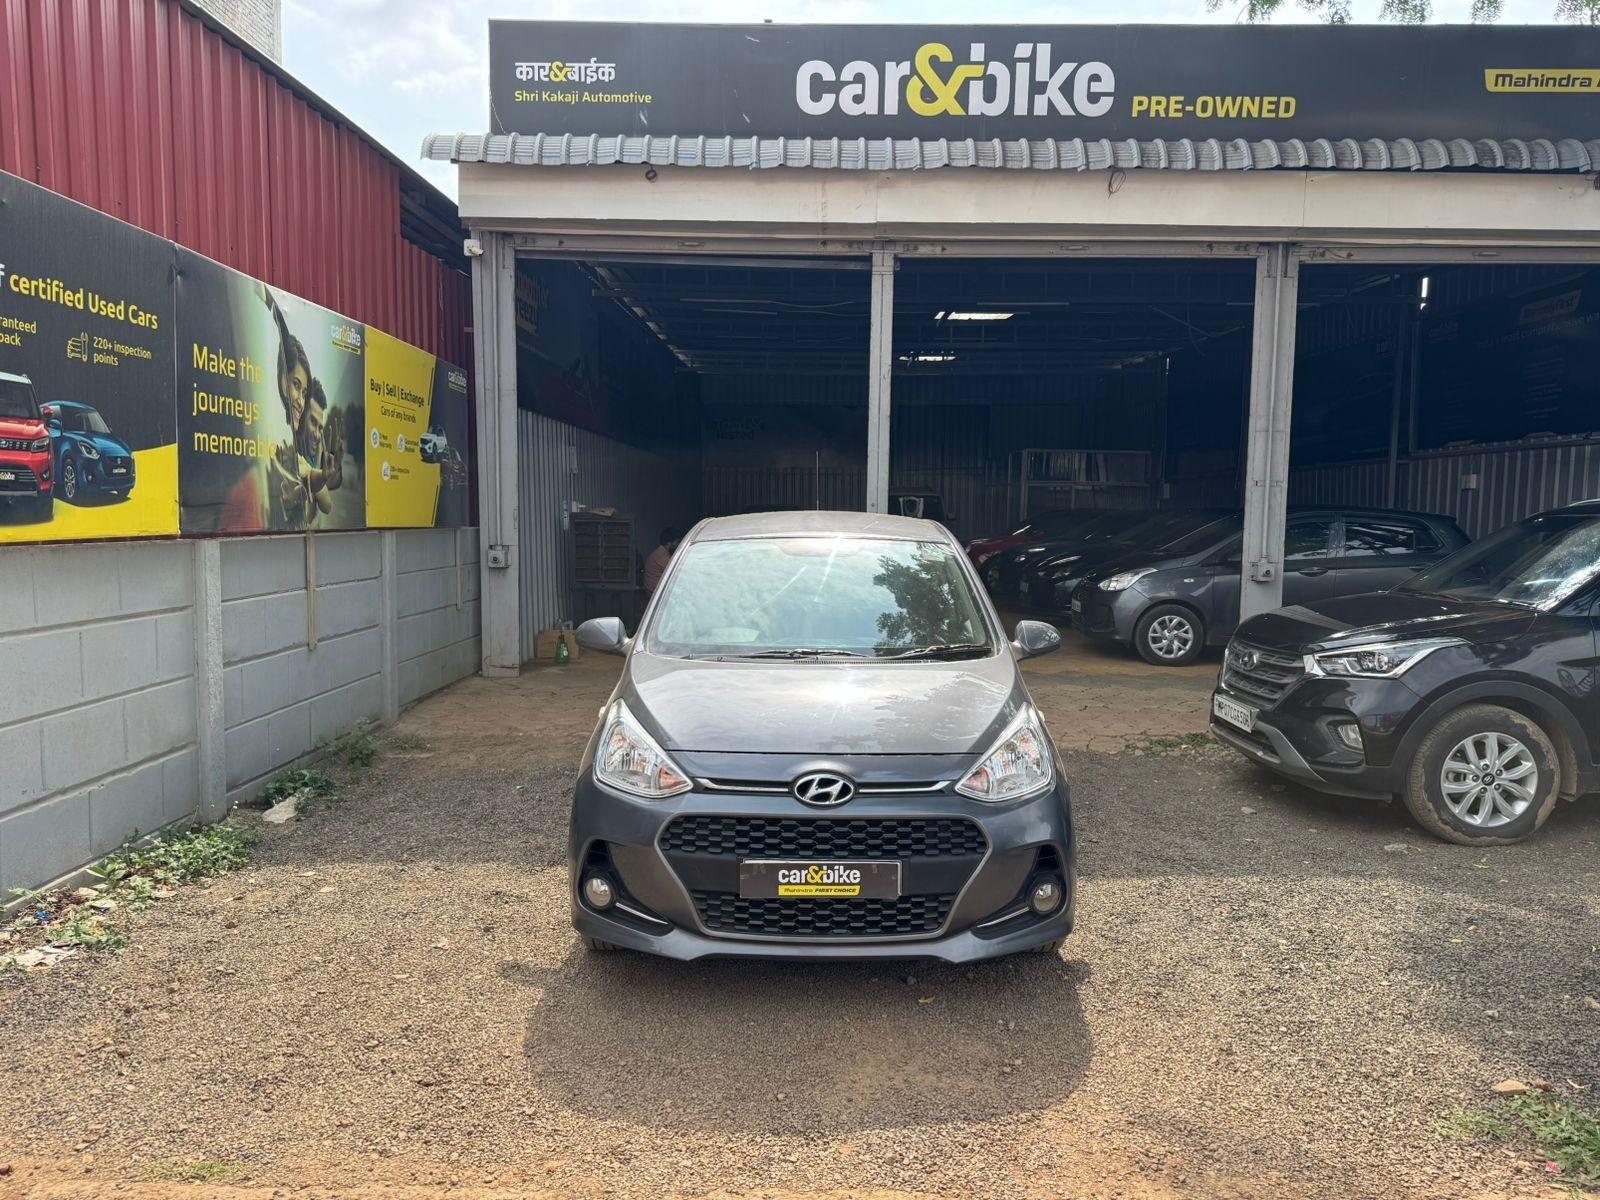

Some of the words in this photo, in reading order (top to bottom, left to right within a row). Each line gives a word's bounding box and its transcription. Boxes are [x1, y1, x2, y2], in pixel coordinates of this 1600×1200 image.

[796, 42, 1115, 117] car&bike
[1494, 73, 1593, 88] Mahindra
[514, 90, 539, 103] Shri
[542, 91, 579, 104] Kakaji
[582, 91, 652, 104] Automotive
[1131, 95, 1297, 119] PRE-OWNED
[9, 274, 84, 310] certified
[88, 292, 125, 321] Used
[128, 304, 159, 330] Cars
[93, 336, 113, 350] 220+
[114, 340, 152, 360] inspection
[93, 352, 119, 366] points
[193, 343, 236, 378] Make
[192, 382, 261, 426] journeys
[370, 378, 382, 396] Buy
[385, 383, 397, 398] Sell
[401, 388, 425, 408] Exchange
[778, 865, 861, 884] car&bike
